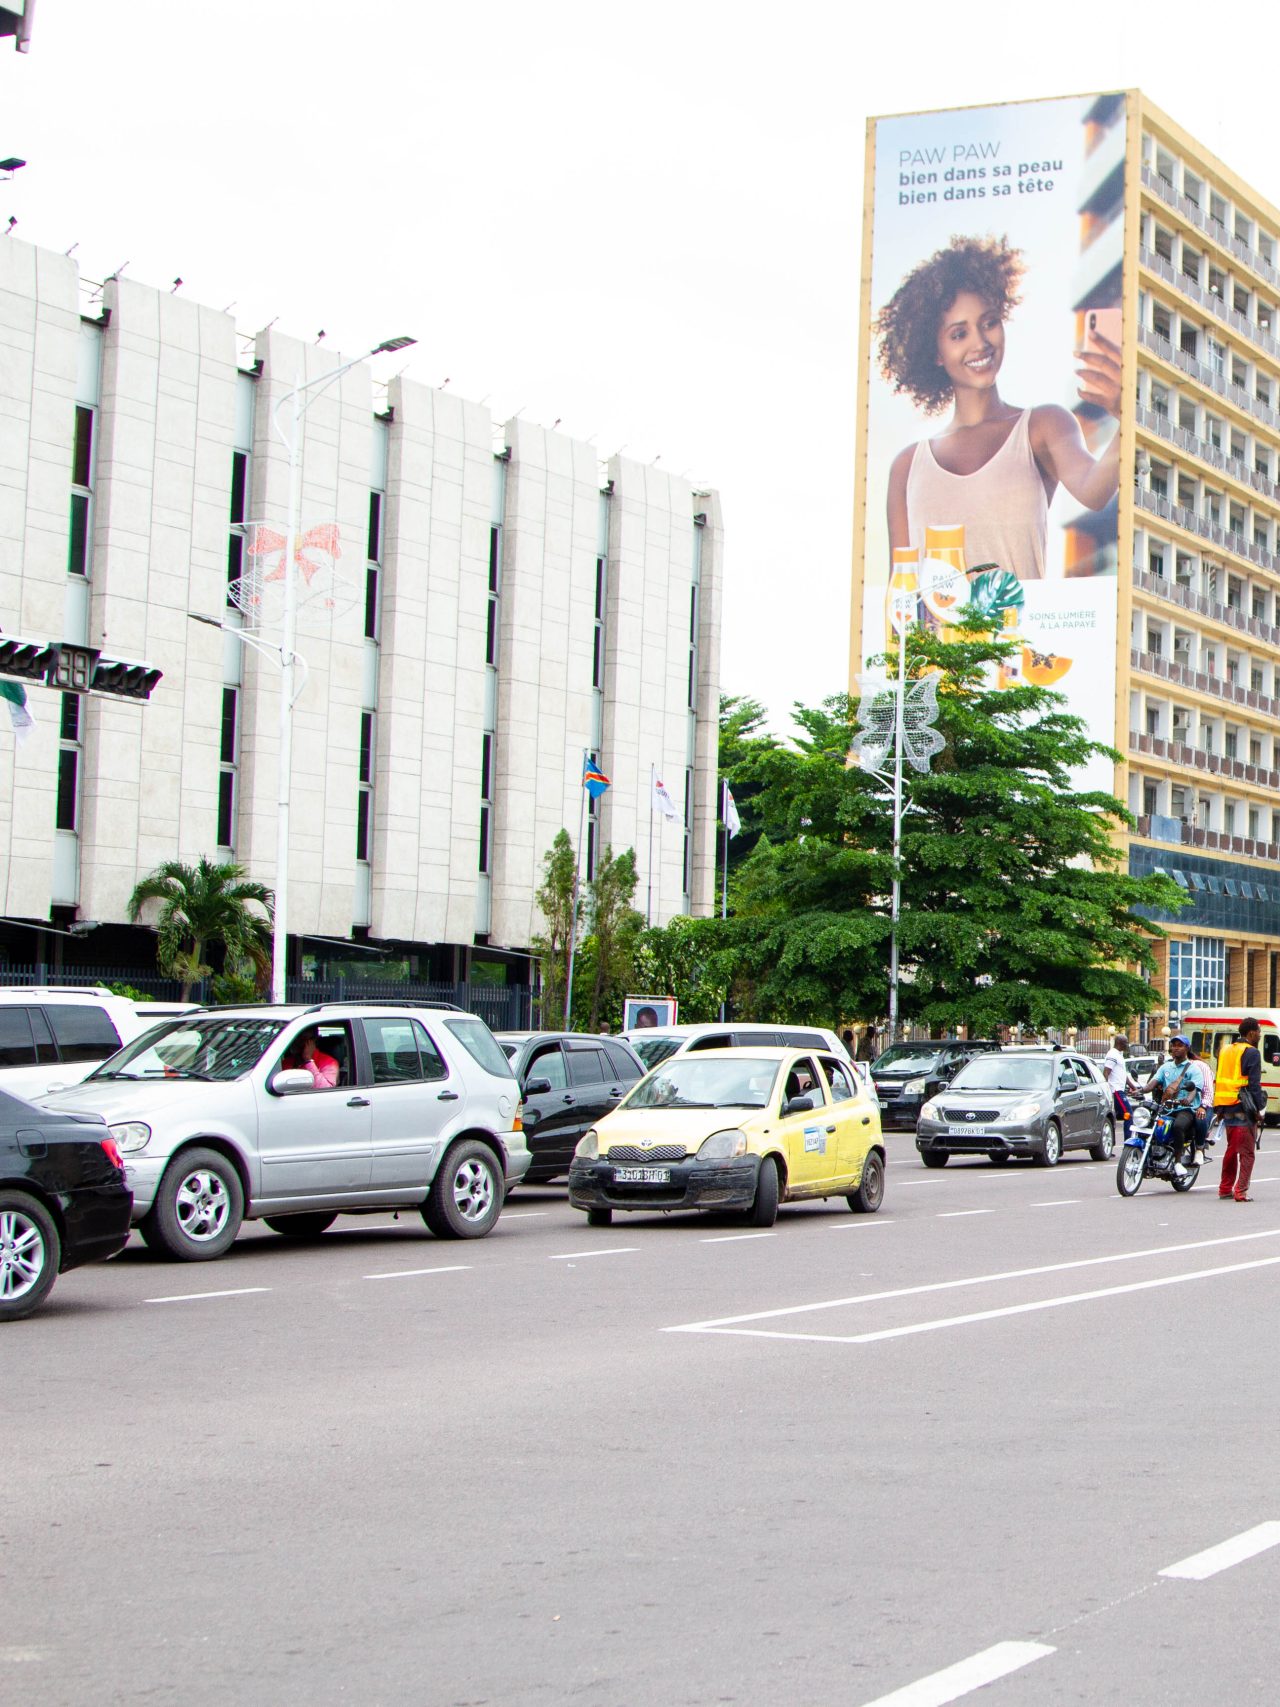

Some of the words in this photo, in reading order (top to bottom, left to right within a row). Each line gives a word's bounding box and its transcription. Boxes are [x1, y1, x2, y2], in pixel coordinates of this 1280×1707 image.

[899, 147, 946, 167] PAW
[953, 141, 1001, 161] PAW
[899, 171, 938, 186] bien
[944, 167, 987, 182] dans
[992, 164, 1011, 177] sa
[1018, 159, 1063, 177] peau
[898, 190, 937, 205] bien
[943, 186, 986, 201] dans
[992, 184, 1011, 196] sa
[1018, 178, 1055, 194] tête
[1029, 612, 1056, 621] SOINS
[1048, 621, 1060, 630] LA
[1062, 620, 1097, 629] PAPAYE
